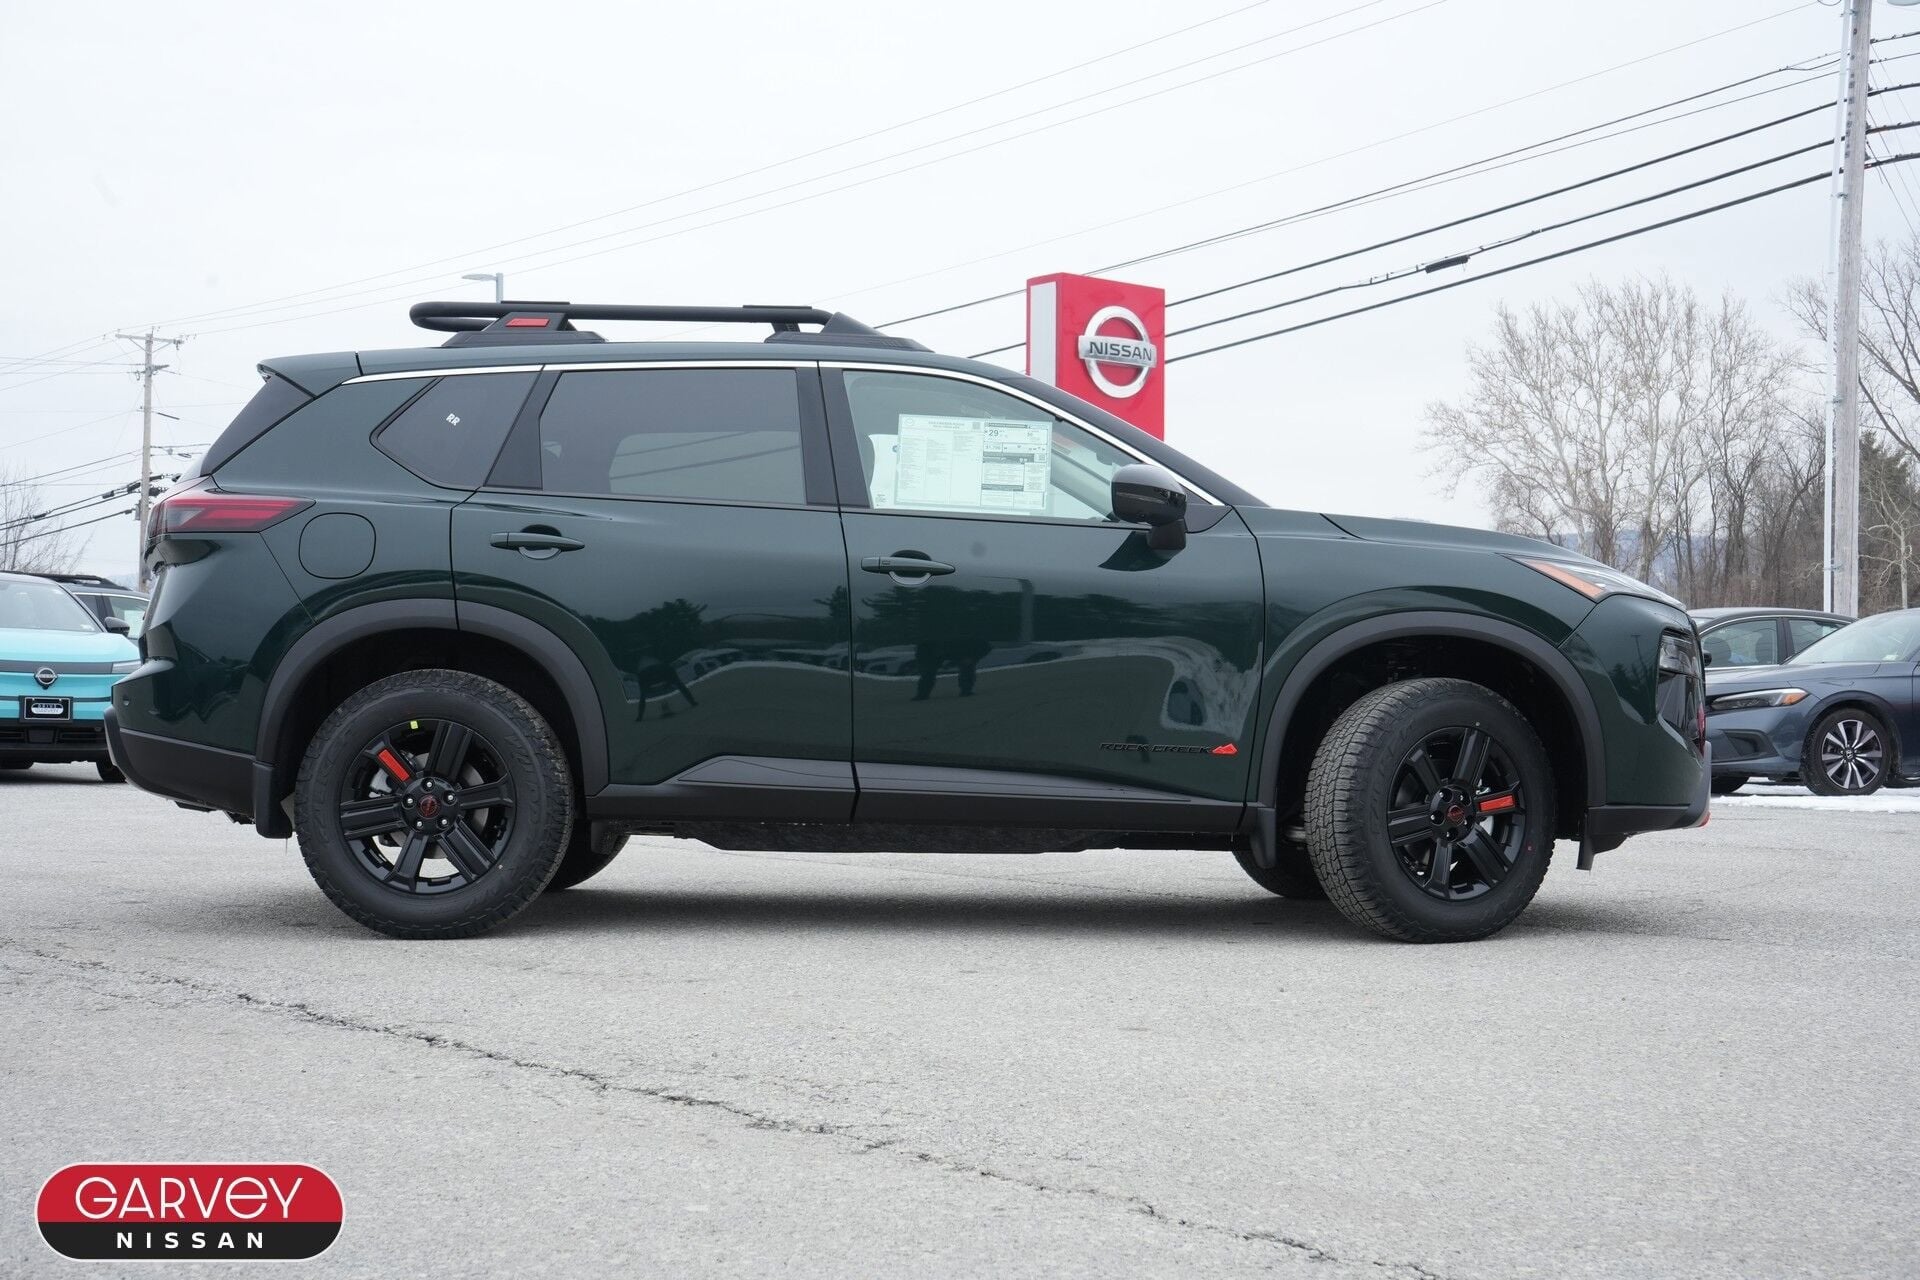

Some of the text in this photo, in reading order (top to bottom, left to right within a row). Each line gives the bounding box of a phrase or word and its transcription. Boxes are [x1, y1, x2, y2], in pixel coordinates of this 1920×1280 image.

[1089, 341, 1152, 362] NISSAN
[445, 413, 461, 426] RR
[988, 429, 999, 437] 29
[1100, 743, 1210, 754] ROCK CREEK
